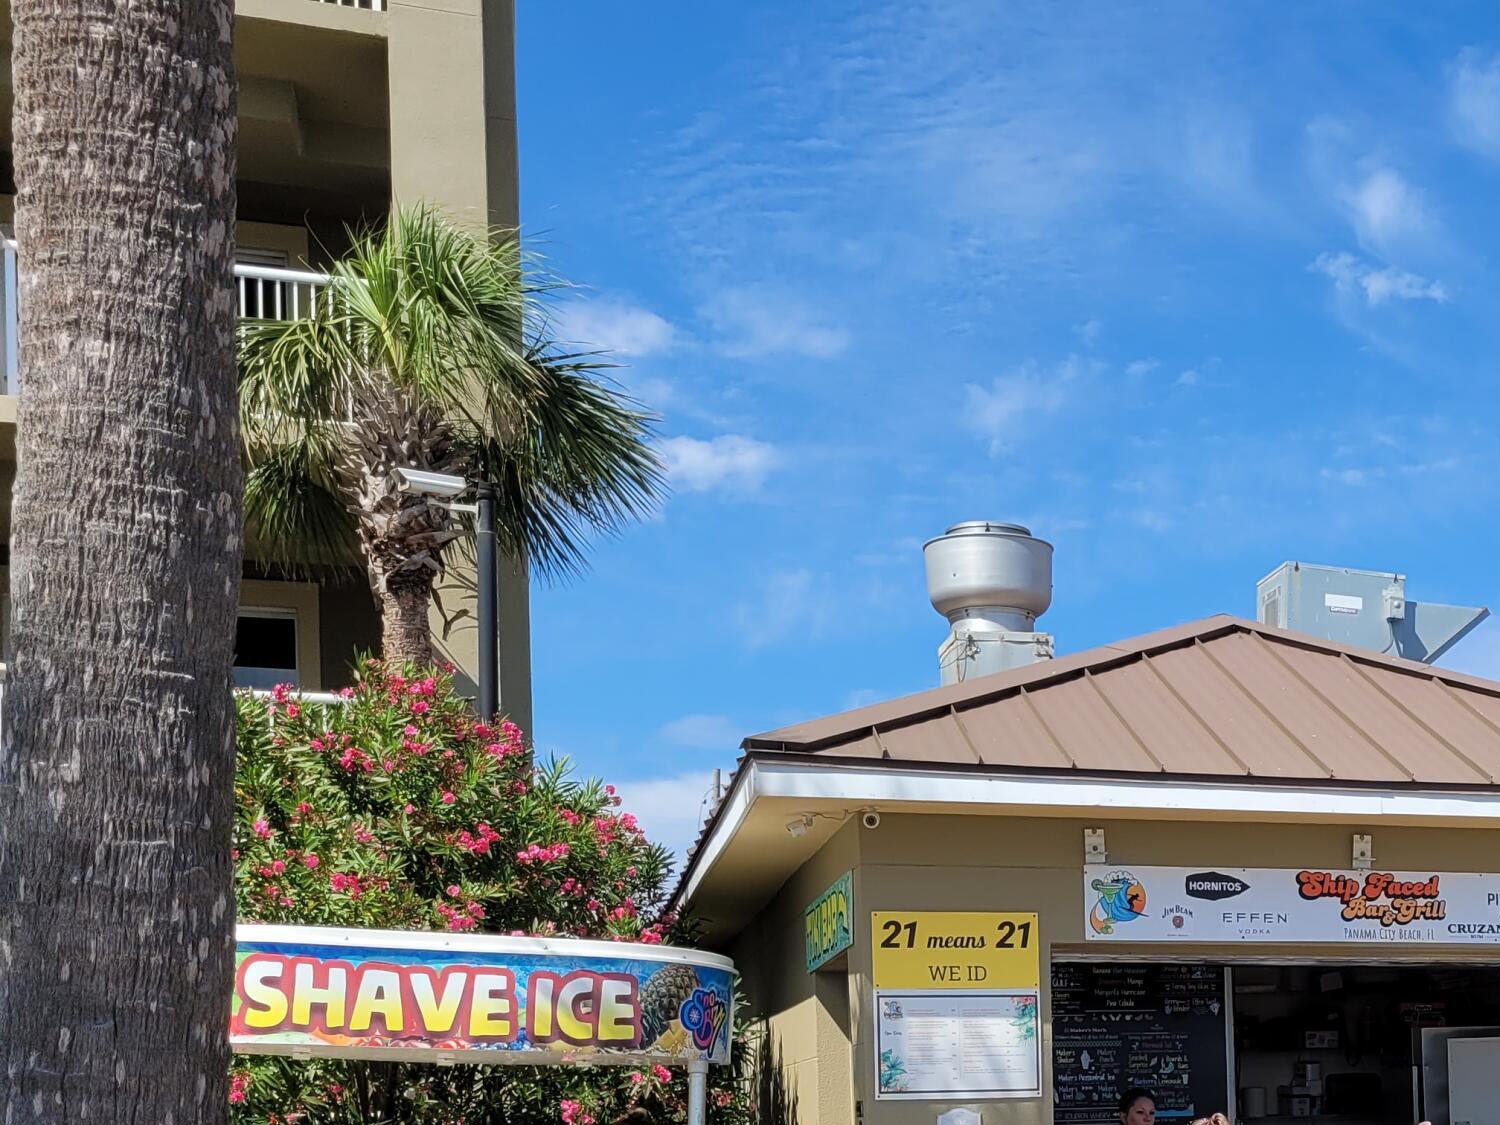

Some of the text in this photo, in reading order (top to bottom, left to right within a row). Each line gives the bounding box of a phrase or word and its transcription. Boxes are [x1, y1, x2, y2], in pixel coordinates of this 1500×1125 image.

[1188, 881, 1242, 892] HORNITOS
[1296, 871, 1440, 904] Ship Faced
[1162, 904, 1194, 919] JIM BEAM
[1222, 912, 1288, 923] EFFEN
[1341, 896, 1390, 921] Bar
[1391, 899, 1446, 924] Grill
[881, 920, 1031, 949] 21 means 21
[928, 965, 987, 981] WE ID
[242, 959, 637, 1042] SHAVE ICE
